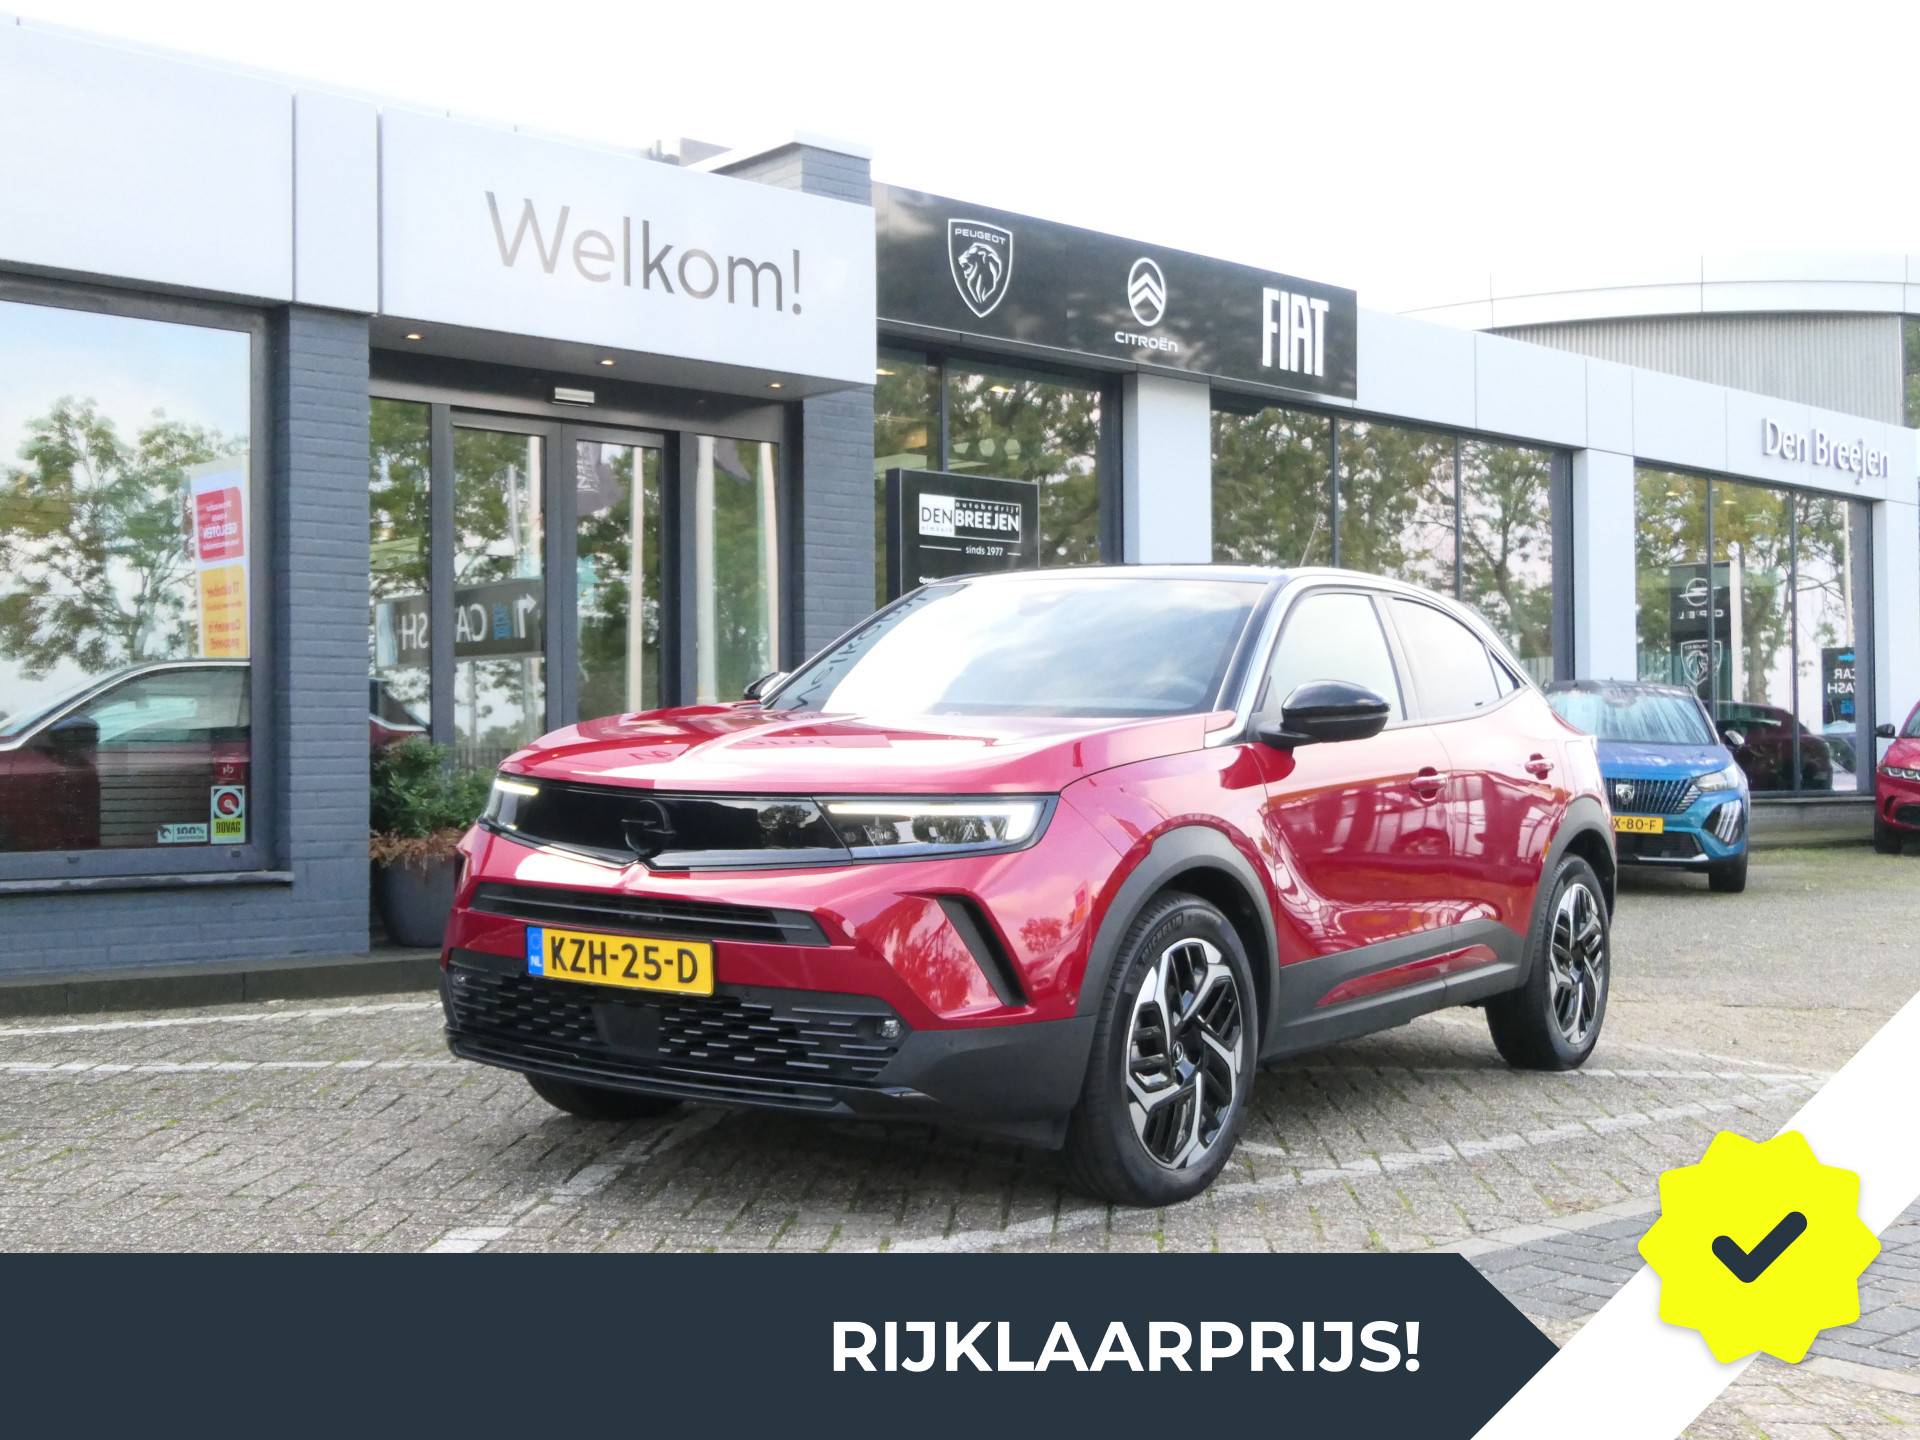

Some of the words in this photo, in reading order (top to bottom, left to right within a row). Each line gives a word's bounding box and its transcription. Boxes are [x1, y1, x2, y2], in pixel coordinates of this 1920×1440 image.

[954, 227, 1007, 246] PEUGEOT
[484, 190, 801, 315] Welkom!
[1262, 287, 1329, 376] FIAT
[1762, 418, 1807, 463] Den
[1811, 428, 1889, 485] Breejen
[955, 502, 1019, 514] autobedrijf
[921, 507, 953, 525] DEN
[955, 509, 1019, 532] BREEJEN
[965, 545, 985, 555] sinds
[987, 547, 1004, 557] 1977
[215, 820, 241, 834] BOVAG
[1613, 817, 1657, 831] X-80-F
[529, 954, 543, 967] NL
[550, 935, 698, 984] KZH-25-D
